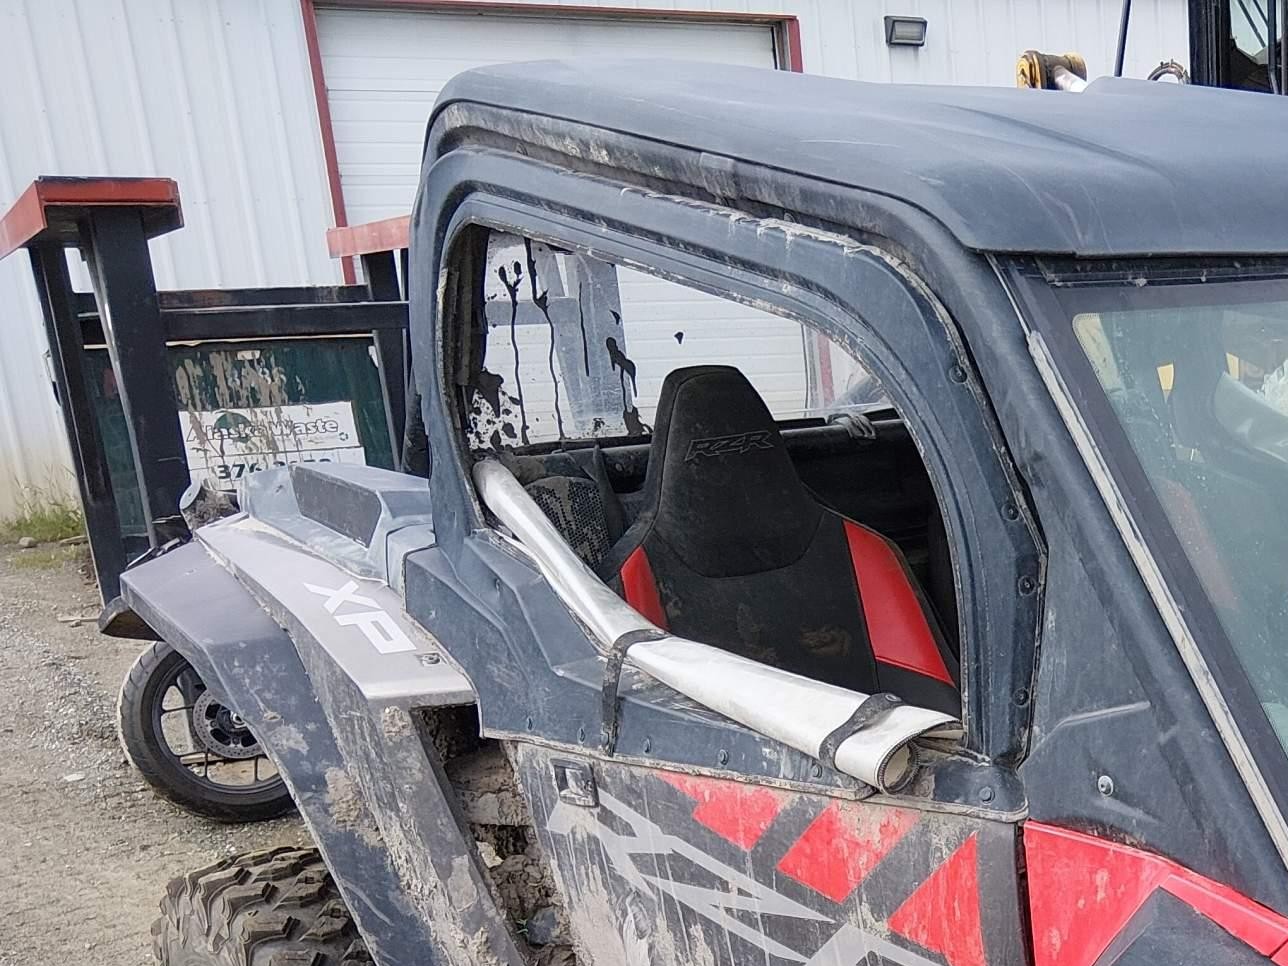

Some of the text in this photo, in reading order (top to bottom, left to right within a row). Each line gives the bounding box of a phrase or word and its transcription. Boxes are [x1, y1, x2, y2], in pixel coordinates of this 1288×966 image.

[186, 418, 339, 442] Alaska Waste
[303, 580, 417, 654] XP
